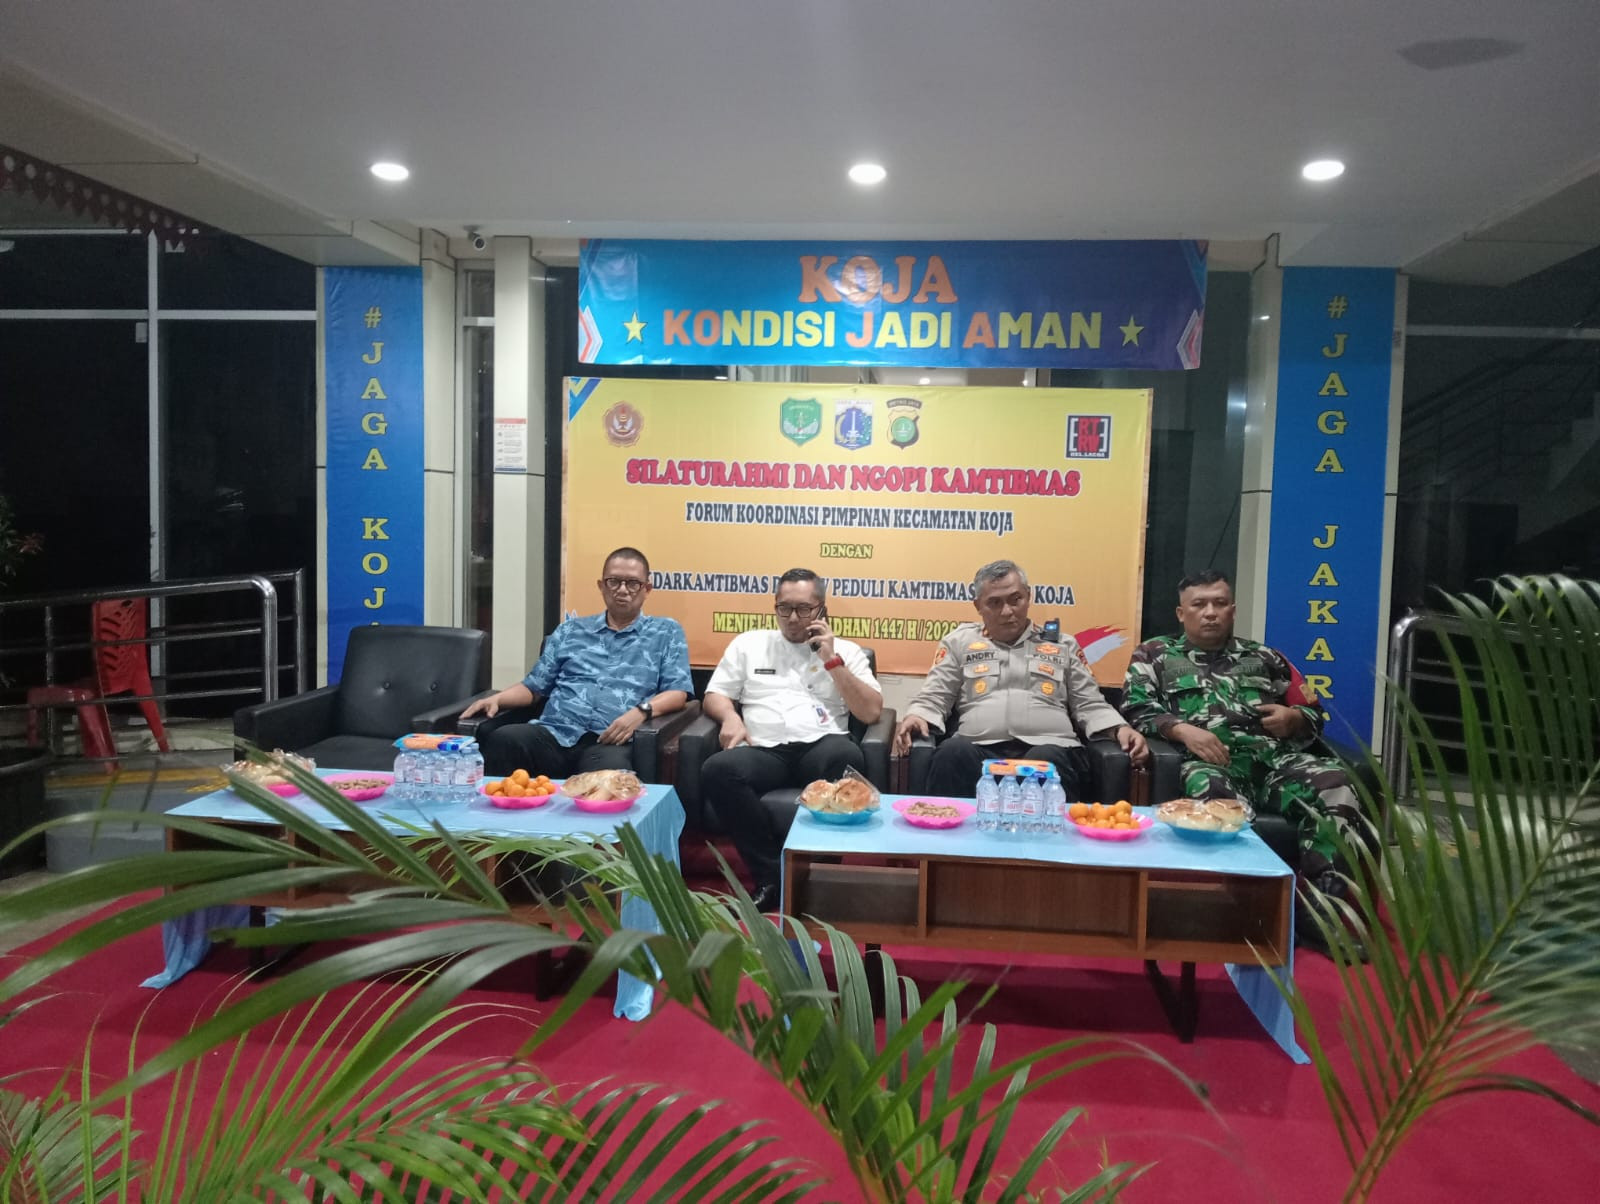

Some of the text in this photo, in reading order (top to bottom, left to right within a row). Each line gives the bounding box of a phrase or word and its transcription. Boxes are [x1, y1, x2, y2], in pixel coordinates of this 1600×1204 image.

[798, 255, 958, 304] KOJA
[662, 308, 1102, 349] KONDISI JADI AMAN
[626, 458, 1081, 496] SILATURAHMI DAN NGOPI KAMTIBMAS
[686, 502, 1013, 536] FORUM KOORDINASI PIMPINAN KECAMATAN KOJA
[820, 543, 872, 559] DENGAN
[361, 517, 389, 626] KOJ
[649, 571, 768, 593] DARKAMTIBMAS
[832, 578, 884, 597] PEDULI
[888, 580, 976, 601] KAMTIBMAS
[1034, 585, 1075, 605] KOJA
[874, 618, 905, 639] 1447
[1305, 524, 1339, 721] JAKAR
[966, 651, 995, 662] ANDRY
[1033, 653, 1064, 665] POLRI
